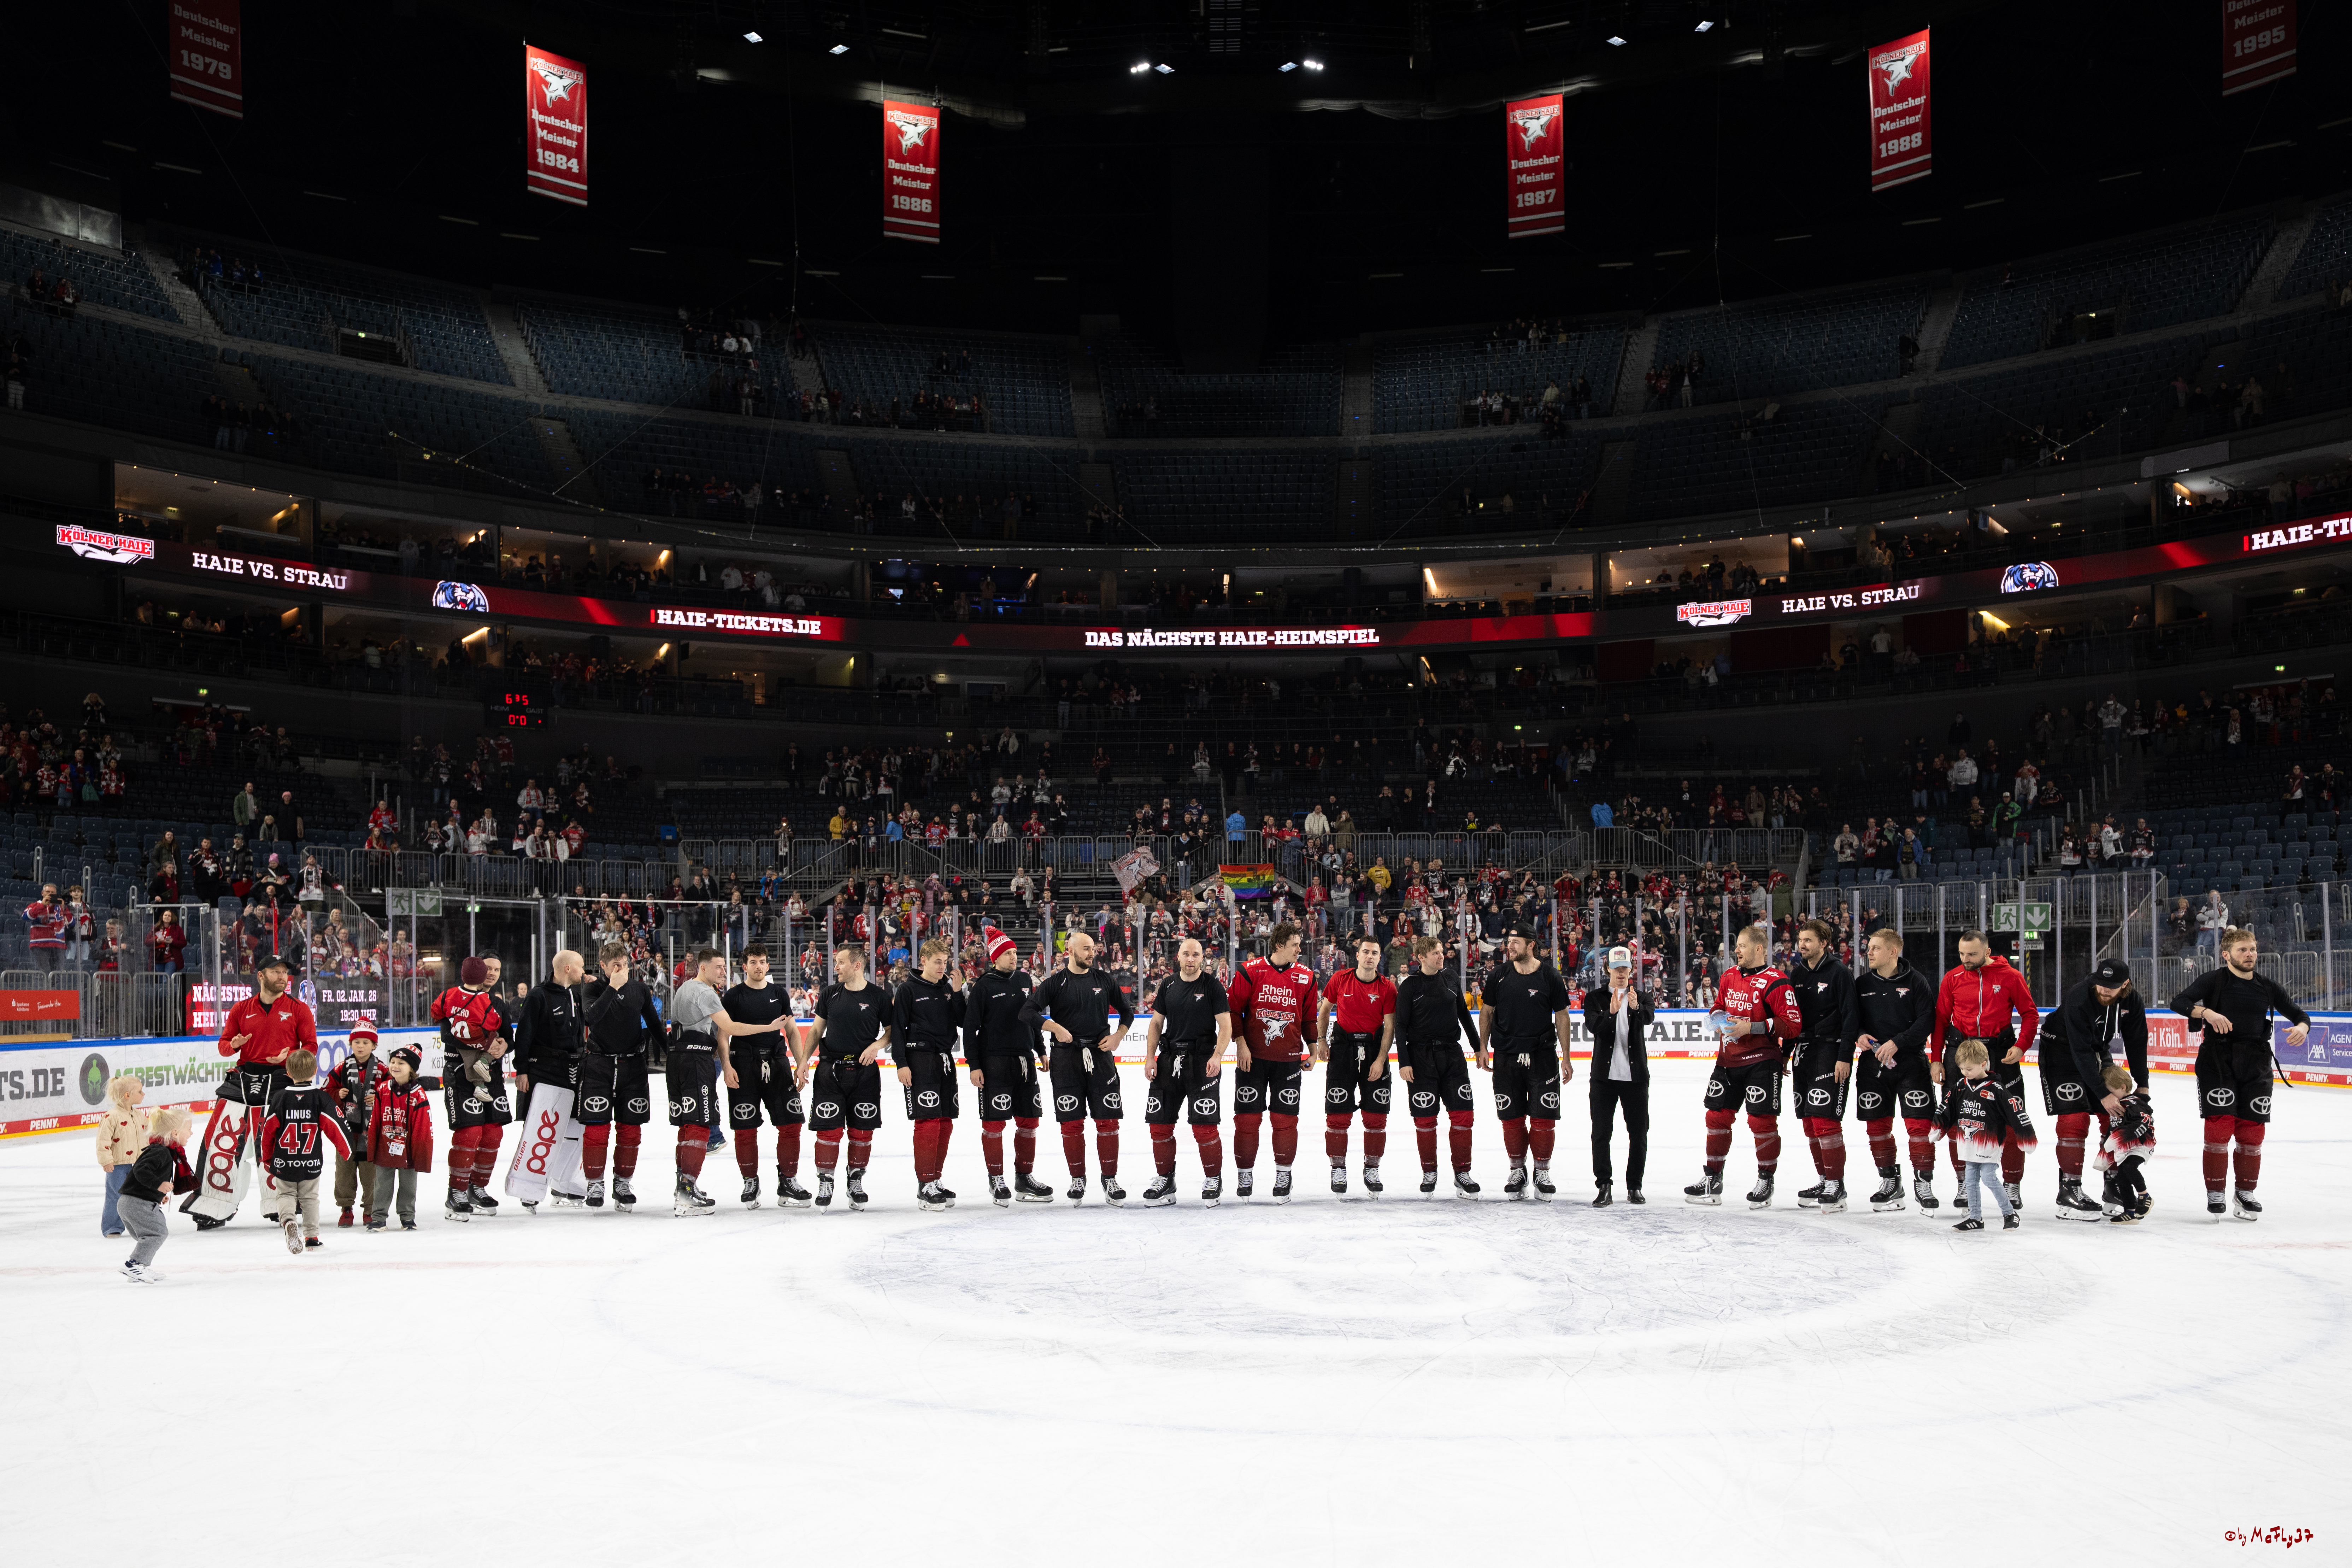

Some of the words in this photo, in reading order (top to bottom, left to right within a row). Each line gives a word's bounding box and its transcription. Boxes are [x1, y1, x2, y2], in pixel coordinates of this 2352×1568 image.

[174, 3, 236, 34] Deutscher
[2234, 5, 2285, 30] Meister
[181, 25, 230, 52] Meister
[2233, 24, 2285, 58] 1995
[181, 49, 231, 80] 1979
[1874, 95, 1927, 118] Deutscher
[531, 108, 583, 133] Deutscher
[1880, 114, 1921, 133] Meister
[537, 128, 577, 148] Meister
[1879, 131, 1922, 158] 1988
[536, 148, 579, 174] 1984
[888, 159, 936, 174] Deutscher
[1511, 155, 1560, 169] Deutscher
[893, 175, 931, 189] Meister
[1516, 172, 1555, 184] Meister
[892, 195, 932, 213] 1986
[1516, 188, 1557, 208] 1987
[59, 527, 114, 547] KÖLNER
[118, 536, 152, 556] HAIE
[2252, 517, 2352, 550] HAIE-TI
[192, 552, 243, 575] HAIE
[248, 561, 278, 580] VS.
[284, 567, 347, 590] STRAU
[1782, 597, 1826, 613] HAIE
[1830, 594, 1857, 609] VS.
[1862, 585, 1920, 605] STRAU
[1680, 604, 1719, 618] KÖLNER
[1723, 601, 1749, 612] HAIE
[657, 609, 821, 634] HAIE-TICKETS.DE
[1085, 632, 1123, 646] DAS
[1127, 628, 1216, 646] NÄCHSTE
[1219, 628, 1380, 646] HAIE-HEIMSPIEL
[506, 693, 512, 704] 6
[522, 695, 528, 705] 5
[322, 990, 334, 1002] FR.
[336, 990, 348, 1002] 02.
[349, 990, 367, 1002] JAN.
[369, 990, 377, 1002] 26
[1258, 992, 1297, 1006] Energie
[1263, 984, 1292, 997] Rhein
[1727, 988, 1748, 1001] Rhein
[1752, 991, 1759, 1003] C
[1785, 990, 1798, 1006] 91
[340, 1010, 359, 1021] 19:30
[1257, 1010, 1279, 1018] KÖLNER
[2159, 1027, 2183, 1048] Köln.
[2330, 1034, 2352, 1043] AGEN
[2309, 1044, 2325, 1059] AXA
[2169, 1063, 2187, 1071] PENNY.
[1201, 1079, 1218, 1091] BAUER
[2306, 1073, 2329, 1083] PENNY.
[1962, 1099, 1981, 1109] Rhein
[2044, 1084, 2053, 1113] TOYOTA
[286, 1109, 311, 1119] LINUS
[30, 1118, 59, 1131] PENNY.
[279, 1122, 318, 1155] 47
[526, 1110, 560, 1175] pape
[207, 1115, 247, 1193] pape
[287, 1159, 321, 1167] TOYOTA
[513, 1140, 527, 1171] BAUER
